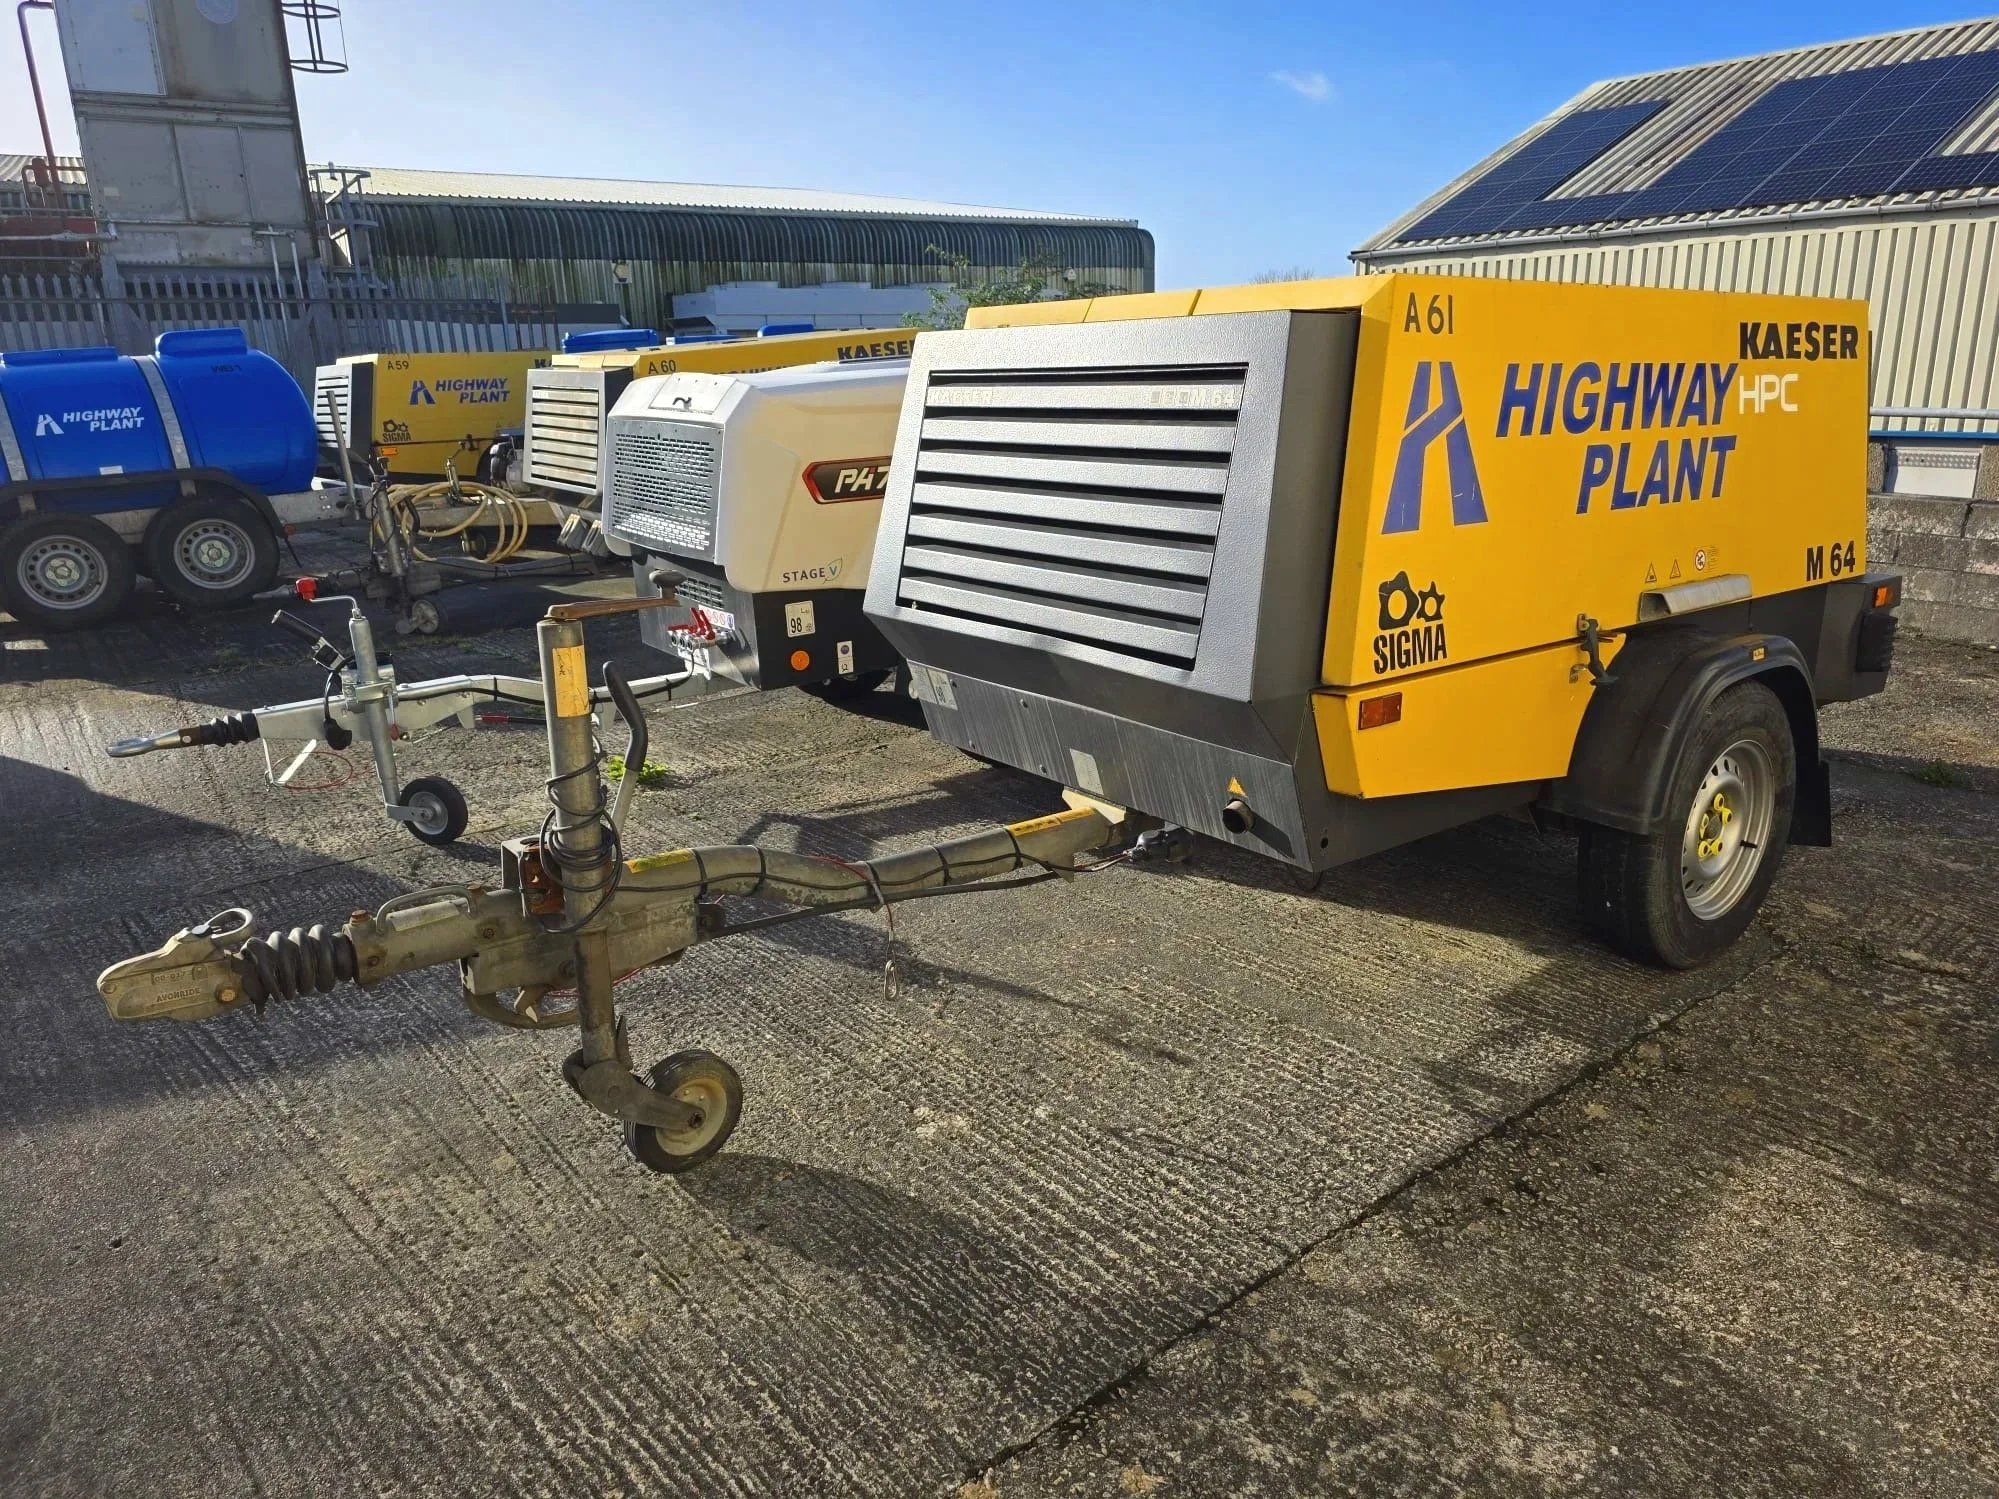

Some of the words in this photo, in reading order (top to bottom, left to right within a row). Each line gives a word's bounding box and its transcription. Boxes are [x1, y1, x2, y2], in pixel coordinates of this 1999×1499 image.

[1740, 321, 1858, 361] KAESER
[435, 377, 509, 392] HIGHWAY
[459, 390, 510, 404] PLANT
[1495, 361, 1739, 438] HIGHWAY
[1739, 373, 1799, 414] HPC
[63, 406, 142, 423] HIGHWAY
[90, 416, 145, 432] PLANT
[382, 432, 412, 443] SIGMA
[1576, 435, 1737, 514] PLANT
[782, 567, 826, 583] STAGE
[790, 617, 803, 633] 98
[1373, 623, 1447, 674] SIGMA
